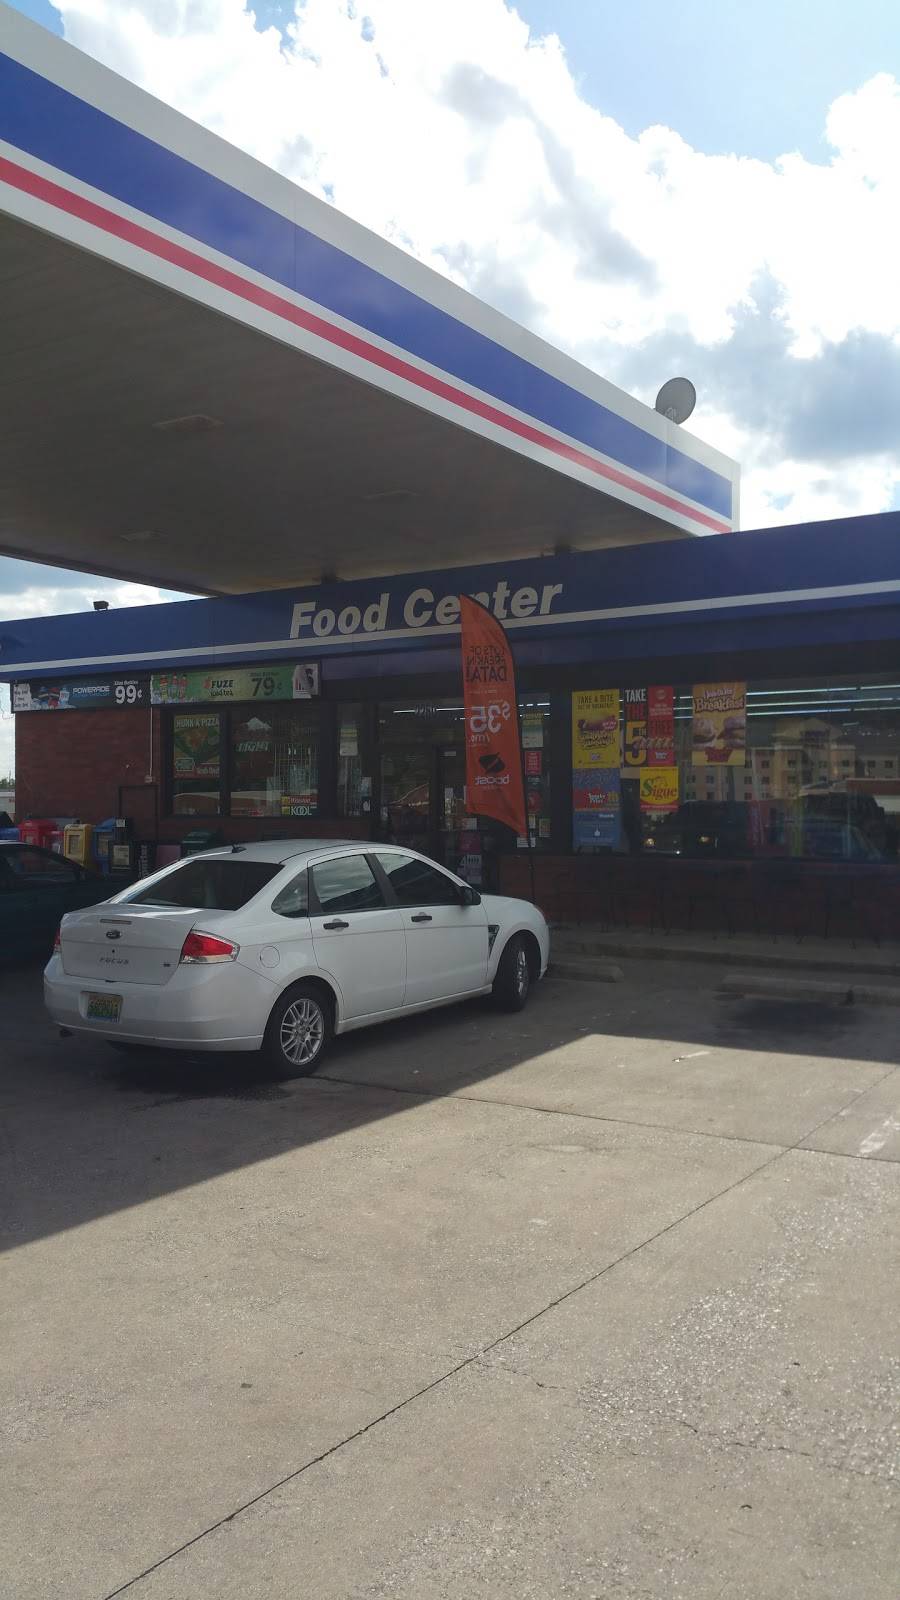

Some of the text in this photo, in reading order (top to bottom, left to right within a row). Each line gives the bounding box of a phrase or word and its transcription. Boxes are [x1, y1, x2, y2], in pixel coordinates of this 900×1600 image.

[289, 593, 390, 639] Food
[211, 679, 233, 688] FUZE
[72, 686, 110, 694] POWERADE
[625, 689, 647, 702] TAKE
[694, 696, 744, 712] Breakfast
[291, 805, 312, 816] KOOL
[99, 957, 129, 965] FOCUS
